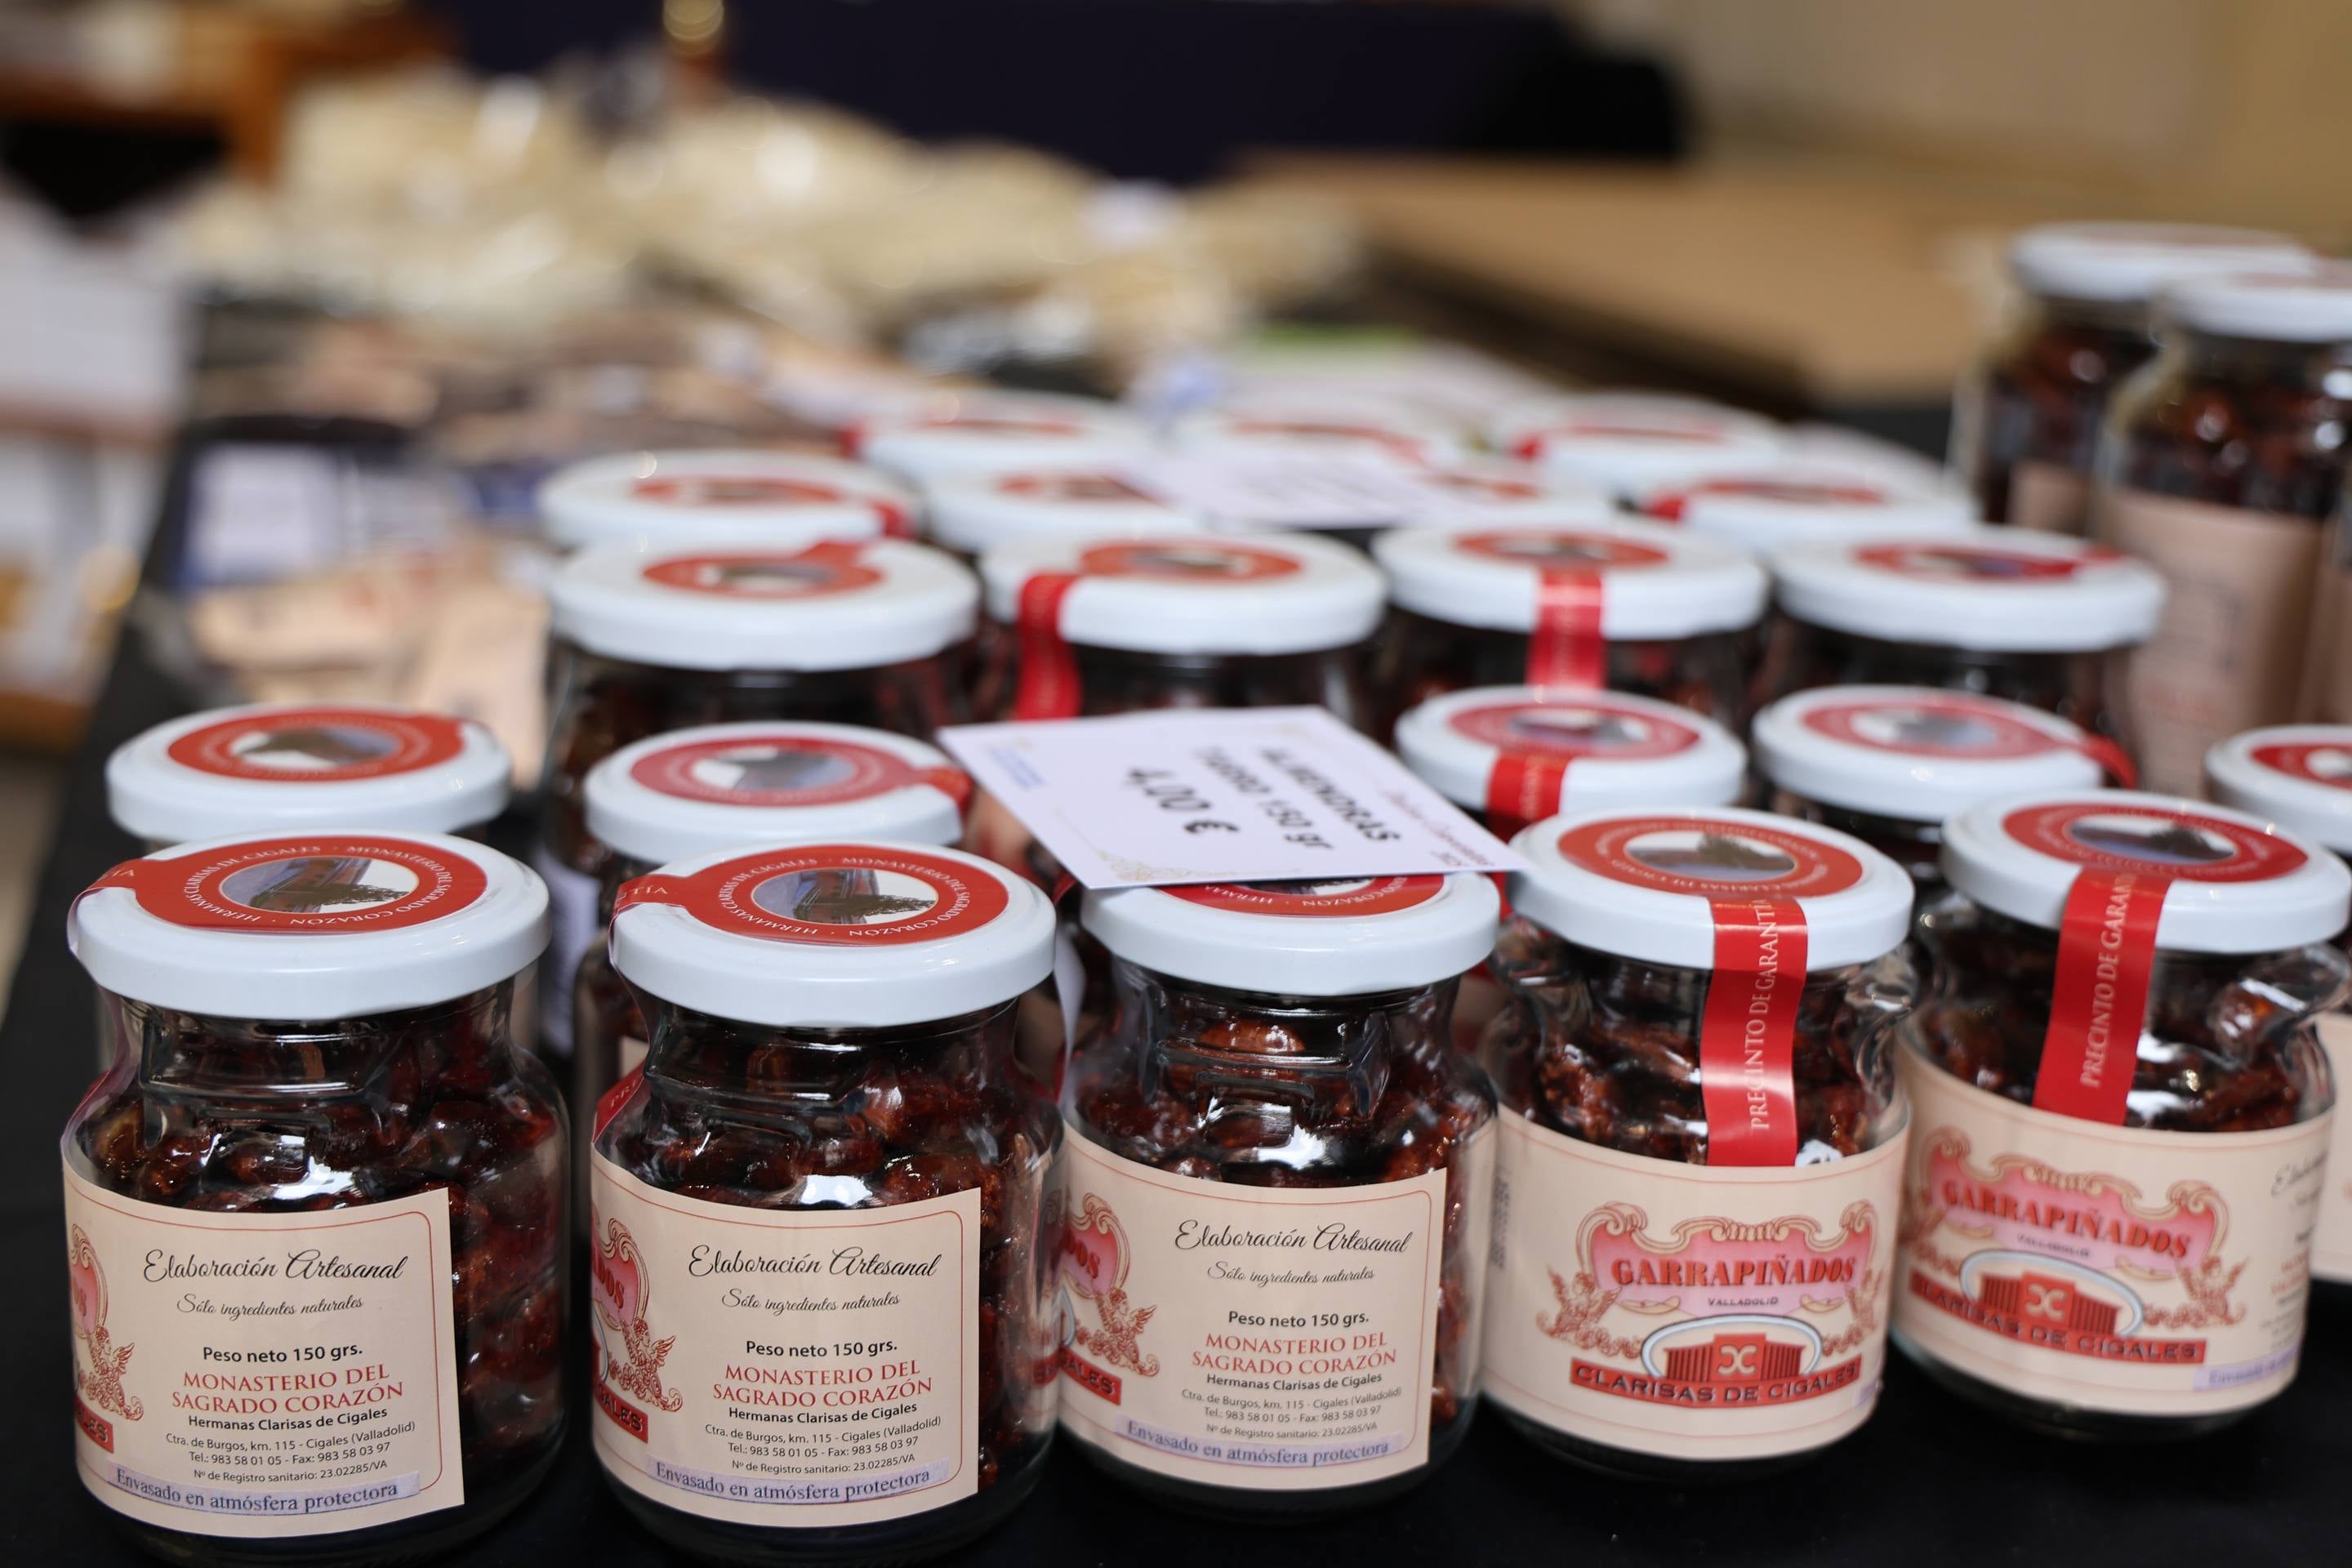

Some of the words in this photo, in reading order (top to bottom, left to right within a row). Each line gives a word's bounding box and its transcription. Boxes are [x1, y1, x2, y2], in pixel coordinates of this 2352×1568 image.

[243, 844, 321, 860] CIGALES
[347, 845, 445, 871] MONASTERIO
[183, 866, 221, 893] CLARISAS
[436, 871, 452, 884] DEL
[751, 858, 817, 874] CIGALES
[842, 858, 950, 880] MONASTERIO
[396, 883, 451, 912] SAGRADO
[719, 882, 739, 909] CLARISAS
[946, 879, 967, 891] DEL
[185, 893, 261, 922] HERMANAS
[290, 911, 393, 925] CORAZÓN
[937, 891, 970, 920] SAGRADO
[730, 909, 817, 934] HERMANAS
[849, 920, 938, 937] CORAZÓN
[2097, 952, 2120, 982] DE
[1749, 994, 1771, 1014] DE
[2080, 982, 2116, 1089] PRECINTO
[1744, 1019, 1770, 1131] PRECINTO
[1942, 1181, 2191, 1258] GARRAPIÑADOS
[1174, 1219, 1307, 1250] Elaboración
[1312, 1223, 1413, 1253] Artesanal
[143, 1249, 278, 1283] Elaboración
[286, 1249, 408, 1279] Artesanal
[688, 1245, 822, 1278] Elaboración
[828, 1247, 942, 1276] Artesanal
[1207, 1261, 1246, 1281] Sólo
[1250, 1268, 1319, 1288] ingredientes
[1322, 1266, 1374, 1282] naturales
[1610, 1254, 1856, 1287] GARRAPIÑADOS
[176, 1293, 217, 1314] Sólo
[220, 1298, 297, 1321] ingredientes
[301, 1294, 364, 1313] naturales
[721, 1287, 761, 1309] Sólo
[764, 1295, 836, 1316] ingredientes
[842, 1290, 900, 1310] naturales
[1708, 1296, 1778, 1306] VALLADOLID
[1228, 1310, 1265, 1326] Peso
[1270, 1314, 1306, 1327] neto
[1312, 1313, 1339, 1326] 150
[1343, 1312, 1370, 1328] grs.
[203, 1347, 242, 1362] Peso
[247, 1348, 287, 1362] neto
[294, 1346, 325, 1361] 150
[331, 1343, 363, 1361] grs.
[746, 1340, 784, 1356] Peso
[789, 1344, 827, 1357] neto
[833, 1341, 863, 1356] 150
[868, 1339, 898, 1356] grs.
[1205, 1332, 1346, 1355] MONASTERIO
[1352, 1331, 1387, 1349] DEL
[2078, 1335, 2198, 1359] CIGALES
[725, 1364, 873, 1385] MONASTERIO
[881, 1359, 920, 1379] DEL
[1192, 1351, 1292, 1375] SAGRADO
[1298, 1348, 1396, 1374] CORAZÓN
[183, 1371, 337, 1392] MONASTERIO
[346, 1364, 390, 1385] DEL
[1207, 1373, 1270, 1389] Hermanas
[1273, 1377, 1320, 1390] Clarisas
[1324, 1375, 1339, 1388] de
[1341, 1372, 1382, 1389] Cigales
[1575, 1364, 1717, 1403] CLARISAS
[1724, 1386, 1757, 1402] DE
[1767, 1364, 1858, 1398] CIGALES
[172, 1392, 277, 1414] SAGRADO
[285, 1382, 403, 1413] CORAZÓN
[713, 1383, 816, 1407] SAGRADO
[823, 1377, 933, 1407] CORAZÓN
[1182, 1388, 1204, 1401] Ctra.
[1207, 1392, 1220, 1403] de
[1223, 1395, 1261, 1410] Burgos,
[1263, 1398, 1283, 1410] km.
[1287, 1399, 1304, 1409] 115
[1313, 1396, 1348, 1410] Cigales
[1351, 1387, 1401, 1405] (Valladolid)
[189, 1416, 255, 1430] Hermanas
[259, 1418, 312, 1430] Clarisas
[316, 1414, 333, 1427] de
[337, 1408, 387, 1427] Cigales
[729, 1407, 794, 1423] Hermanas
[797, 1411, 848, 1423] Clarisas
[852, 1408, 868, 1421] de
[871, 1402, 917, 1421] Cigales
[166, 1432, 189, 1446] Ctra.
[191, 1437, 204, 1448] de
[207, 1438, 247, 1454] Burgos,
[251, 1439, 271, 1451] km.
[276, 1441, 295, 1450] 115
[306, 1435, 348, 1450] Cigales
[351, 1421, 416, 1445] (Valladolid)
[705, 1423, 728, 1437] Ctra.
[730, 1428, 743, 1439] de
[746, 1430, 786, 1445] Burgos,
[789, 1432, 808, 1444] km.
[813, 1433, 831, 1442] 115
[842, 1428, 880, 1444] Cigales
[884, 1416, 942, 1438] (Valladolid)
[1128, 1419, 1199, 1453] Envasado
[1204, 1443, 1222, 1458] en
[1227, 1447, 1308, 1463] atmósfera
[1313, 1441, 1388, 1468] protectora
[189, 1451, 209, 1463] Tel.:
[212, 1454, 231, 1464] 983
[234, 1455, 247, 1465] 58
[251, 1455, 264, 1465] 01
[268, 1455, 281, 1464] 05
[293, 1452, 315, 1464] Fax:
[318, 1450, 339, 1462] 983
[343, 1447, 356, 1459] 58
[359, 1445, 373, 1456] 03
[376, 1441, 390, 1453] 97
[728, 1441, 747, 1454] Tel.:
[750, 1445, 769, 1456] 983
[773, 1447, 786, 1457] 58
[789, 1447, 801, 1457] 01
[804, 1447, 817, 1457] 05
[828, 1446, 849, 1457] Fax:
[852, 1443, 871, 1455] 983
[875, 1441, 888, 1452] 58
[891, 1439, 904, 1450] 03
[906, 1436, 918, 1446] 97
[194, 1468, 206, 1478] Nº
[207, 1471, 220, 1480] de
[224, 1472, 265, 1485] Registro
[268, 1470, 318, 1483] sanitario:
[320, 1459, 387, 1479] 23.02285/VA
[733, 1459, 744, 1469] Nº
[746, 1461, 758, 1471] de
[761, 1462, 801, 1476] Registro
[804, 1462, 851, 1474] sanitario:
[853, 1453, 915, 1471] 23.02285/VA
[116, 1468, 180, 1502] Envasado
[186, 1494, 204, 1507] en
[210, 1493, 298, 1511] atmósfera
[305, 1481, 398, 1512] protectora
[657, 1461, 724, 1494] Envasado
[730, 1481, 748, 1497] en
[754, 1484, 839, 1500] atmósfera
[845, 1469, 929, 1502] protectora
